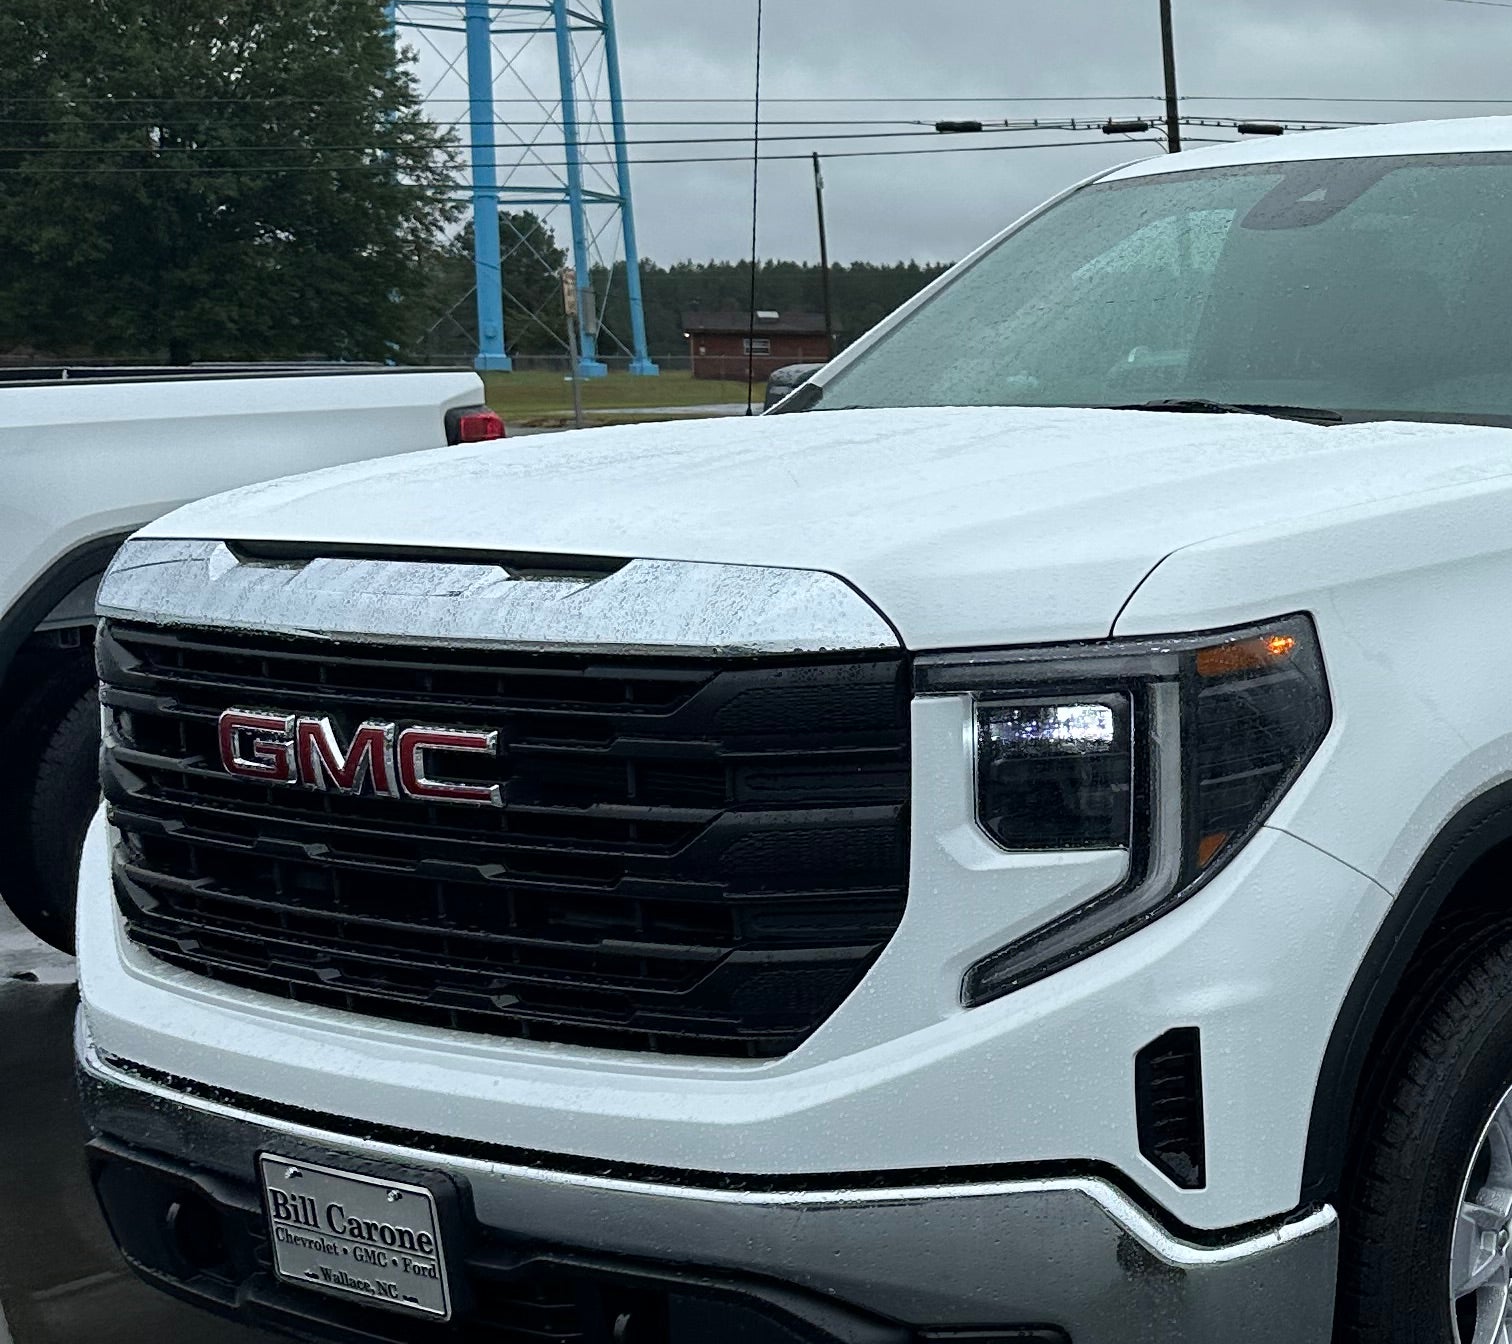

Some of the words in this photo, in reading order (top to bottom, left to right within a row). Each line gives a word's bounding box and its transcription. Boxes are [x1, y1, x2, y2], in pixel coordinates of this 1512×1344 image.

[217, 707, 503, 808] GMC
[269, 1186, 320, 1229] Bill
[326, 1202, 434, 1255] Carone
[274, 1226, 340, 1256] Chevrolet
[352, 1245, 388, 1268] GMC
[401, 1256, 439, 1280] Ford
[319, 1265, 375, 1295] Wallace,
[376, 1280, 399, 1299] NC
